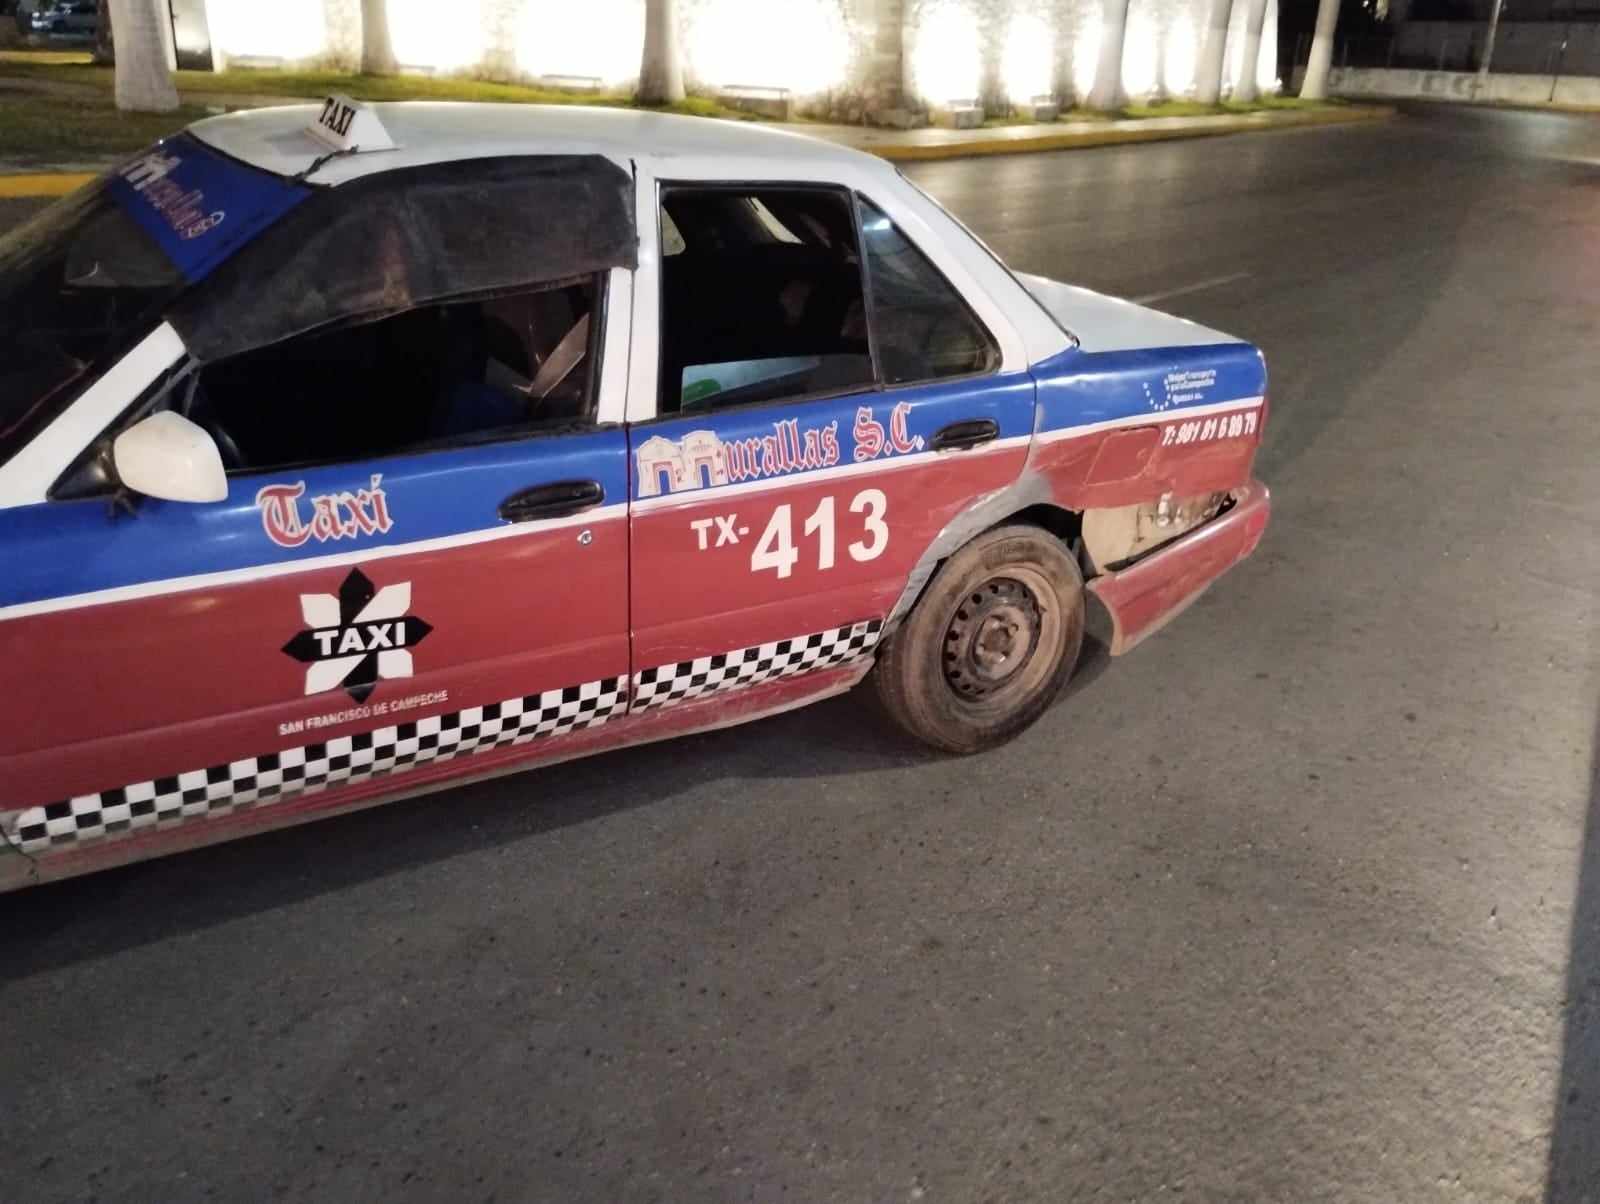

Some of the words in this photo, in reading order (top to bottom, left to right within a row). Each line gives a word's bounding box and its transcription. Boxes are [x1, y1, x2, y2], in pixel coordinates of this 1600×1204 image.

[318, 97, 356, 137] TAXI
[853, 401, 925, 462] S.C.
[313, 621, 406, 656] TAXI
[279, 720, 304, 736] SAN
[306, 705, 372, 729] FRANCISCO
[373, 703, 389, 716] DE
[390, 690, 448, 712] CAMPECHE
